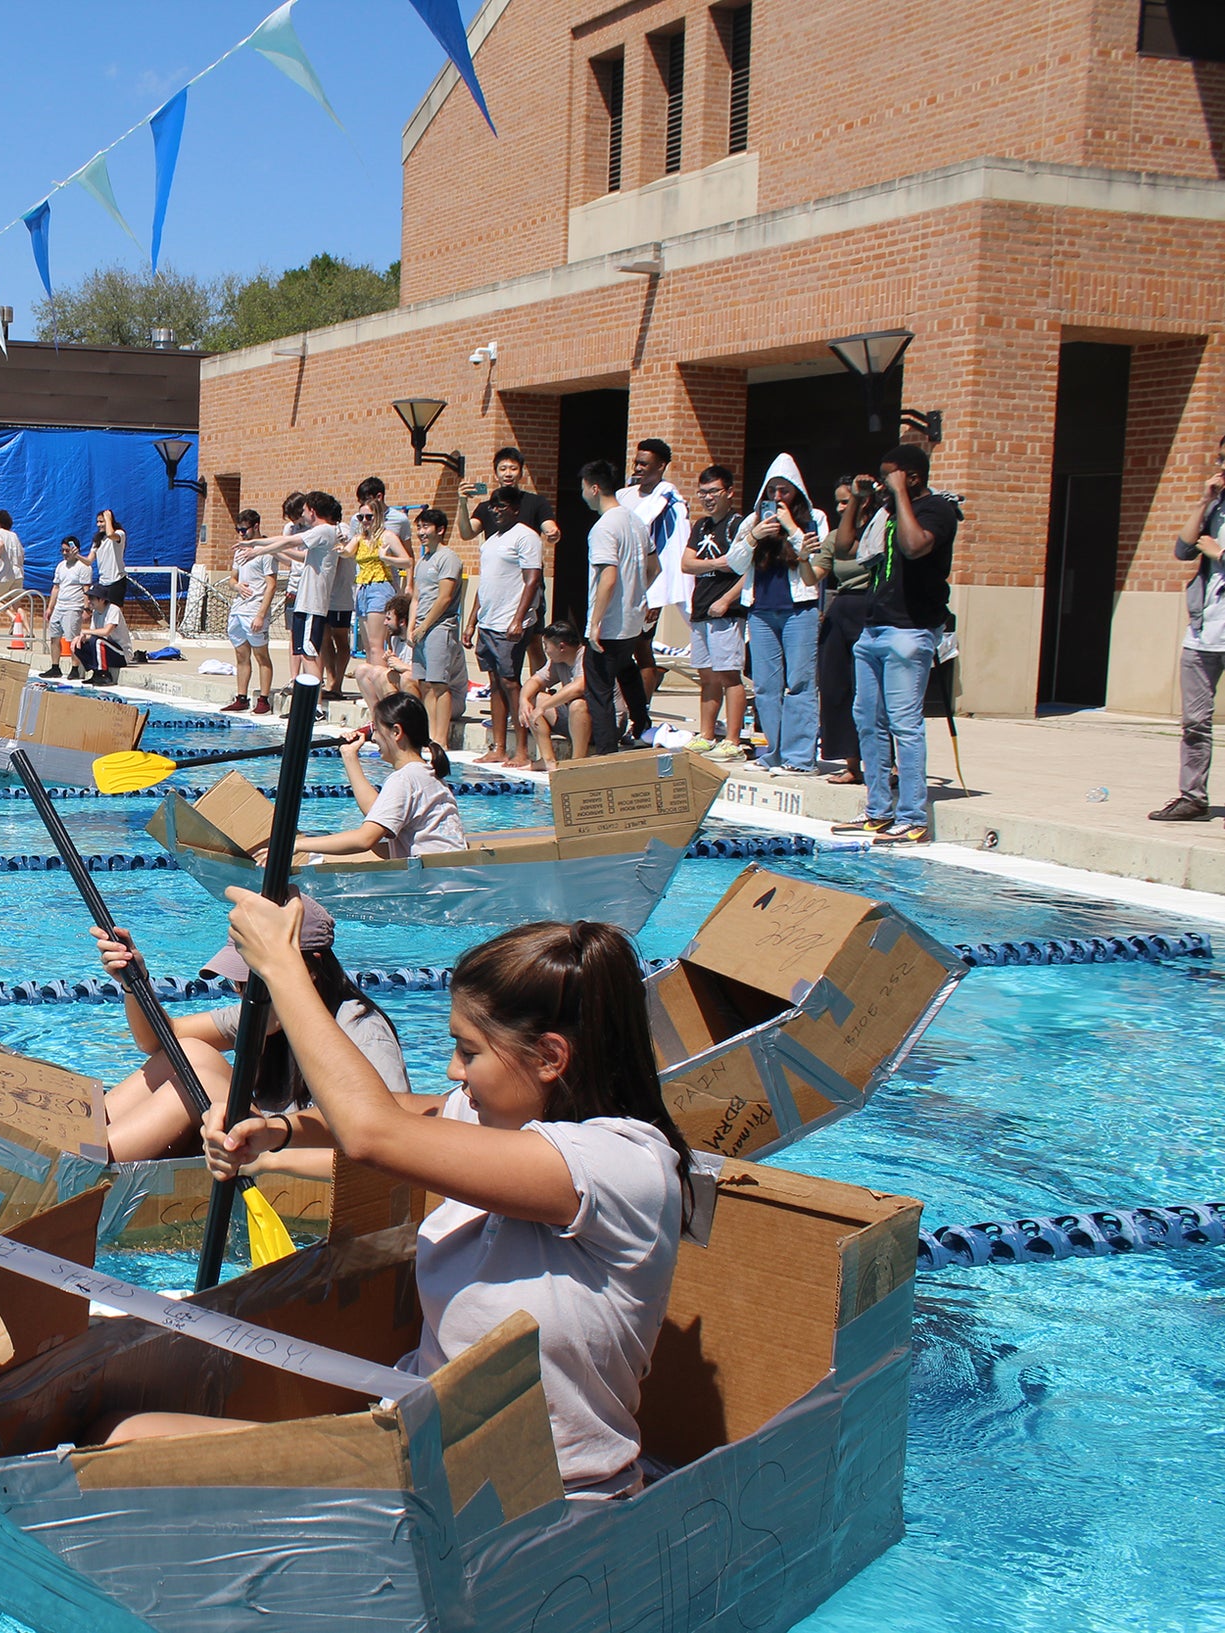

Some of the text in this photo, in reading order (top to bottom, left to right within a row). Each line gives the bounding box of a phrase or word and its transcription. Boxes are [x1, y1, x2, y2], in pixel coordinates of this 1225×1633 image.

[673, 1060, 727, 1113] PAIN
[701, 1095, 747, 1150] BDRM
[210, 1322, 313, 1372] AHOY!
